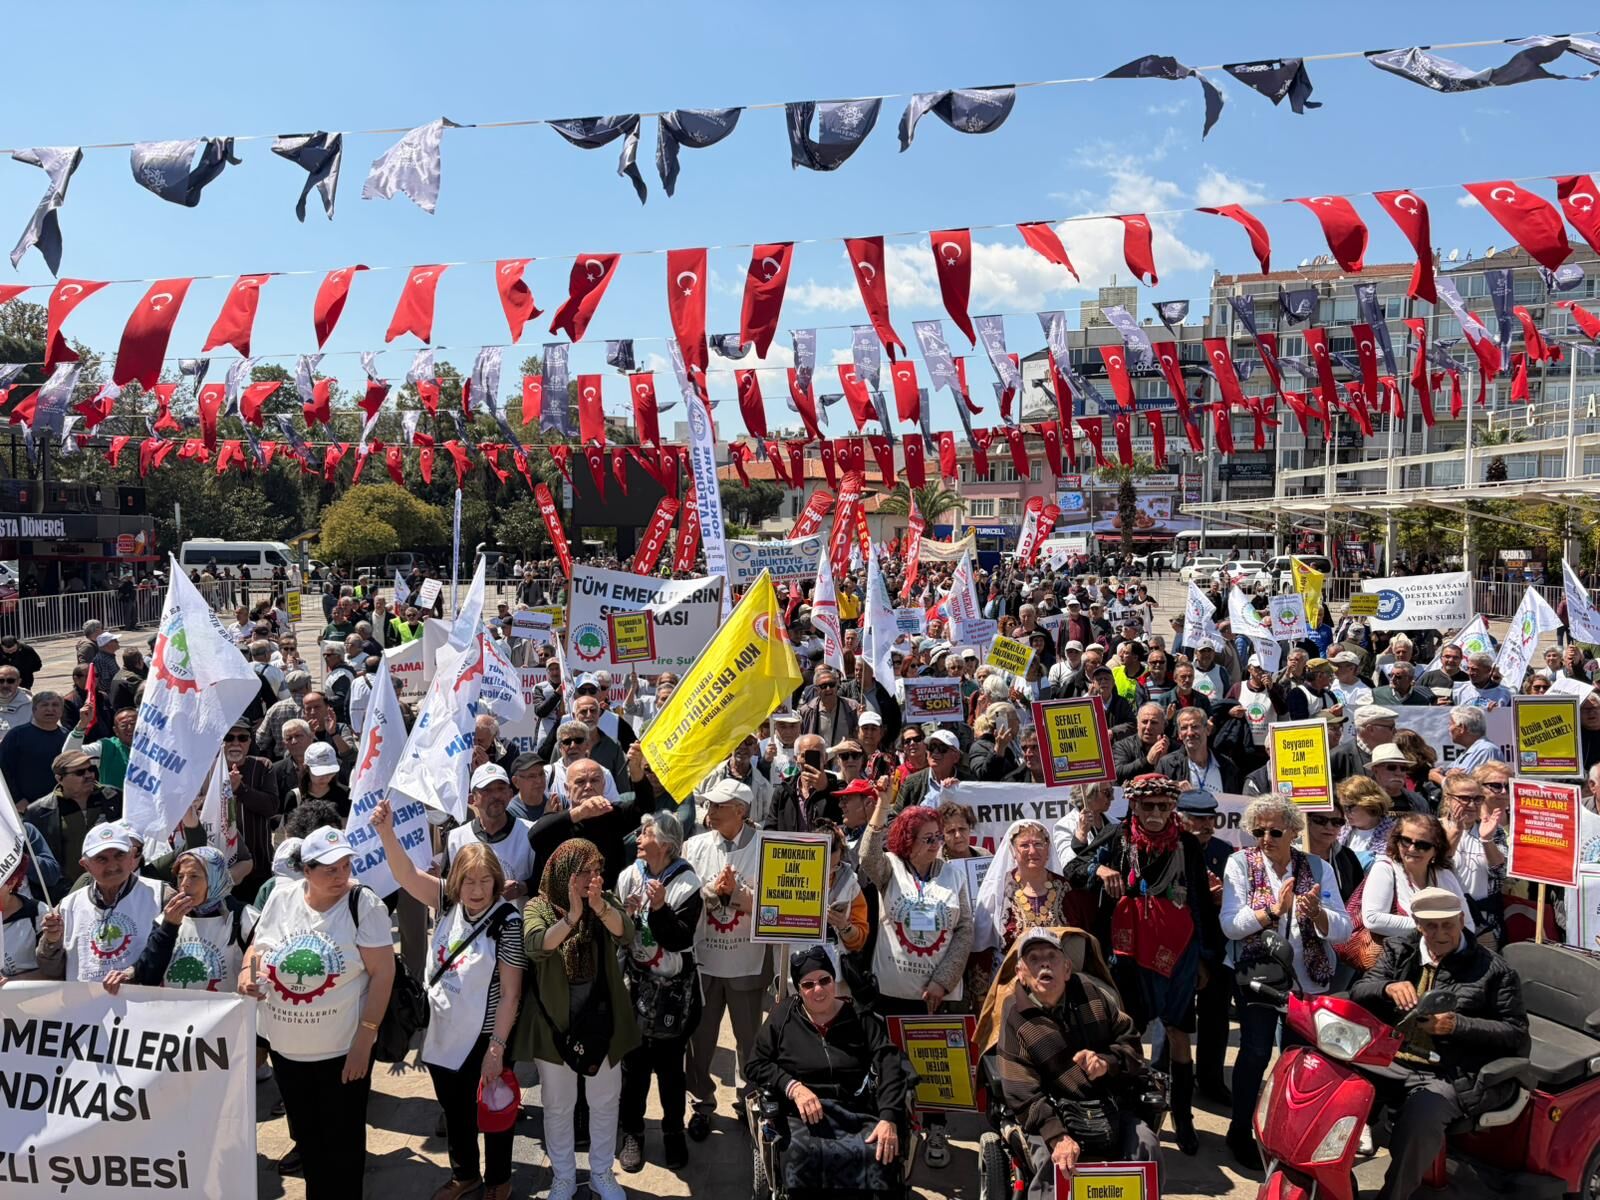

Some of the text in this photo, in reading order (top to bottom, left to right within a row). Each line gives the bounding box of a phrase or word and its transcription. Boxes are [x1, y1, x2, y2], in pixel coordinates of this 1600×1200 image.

[839, 493, 860, 502] CHP
[686, 501, 697, 510] CH
[656, 508, 674, 521] CHP
[804, 507, 823, 522] CHP
[21, 516, 65, 537] DÖNERCİ
[976, 527, 1006, 536] TURKCELL
[638, 520, 666, 572] AYDIN
[679, 511, 697, 568] AYDIN
[757, 546, 794, 557] BİRİZ
[750, 555, 804, 568] BİRLİKTEYİZ
[573, 576, 609, 598] TÜM
[1405, 591, 1464, 600] DESTEKLEME
[1406, 614, 1432, 623] AYDIN
[169, 662, 189, 677] 2017
[140, 702, 169, 731] TÜM
[1054, 713, 1082, 727] SEFALET
[1520, 714, 1564, 737] ÖZGÜR BASIN
[1057, 725, 1088, 740] ZULMÜNE
[1282, 739, 1314, 751] Seyyanen
[1292, 751, 1306, 762] ZAM
[1280, 766, 1301, 776] Hemen
[1553, 792, 1568, 801] YOK
[1520, 797, 1568, 810] FAİZE VAR!
[772, 848, 816, 860] DEMOKRATİK
[784, 860, 801, 873] LAİK
[49, 1150, 189, 1193] ŞUBESİ
[1087, 1184, 1124, 1198] Emekliler
